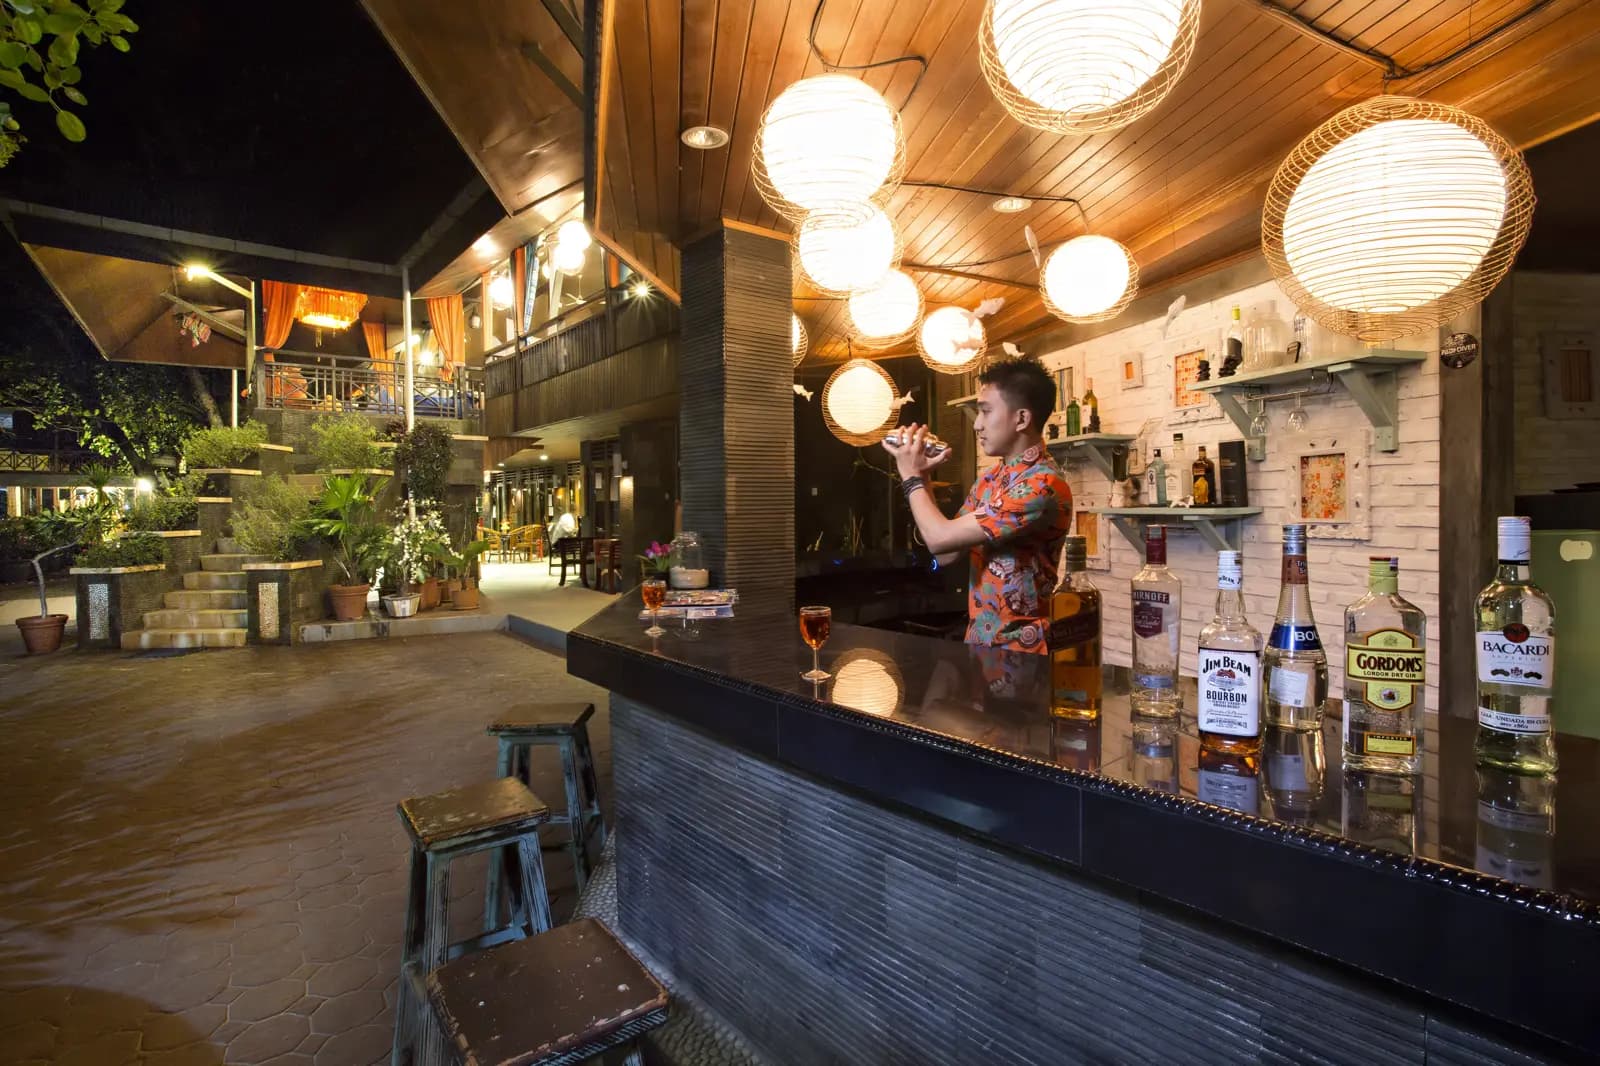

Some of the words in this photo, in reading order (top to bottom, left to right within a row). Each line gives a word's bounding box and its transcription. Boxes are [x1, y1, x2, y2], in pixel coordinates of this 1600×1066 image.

[1295, 630, 1320, 642] BOL
[1482, 640, 1550, 656] BACARDI
[1202, 658, 1221, 674] JIM
[1222, 655, 1252, 677] BEAM
[1356, 653, 1423, 673] GORDON'S
[1206, 690, 1247, 703] BOURBON
